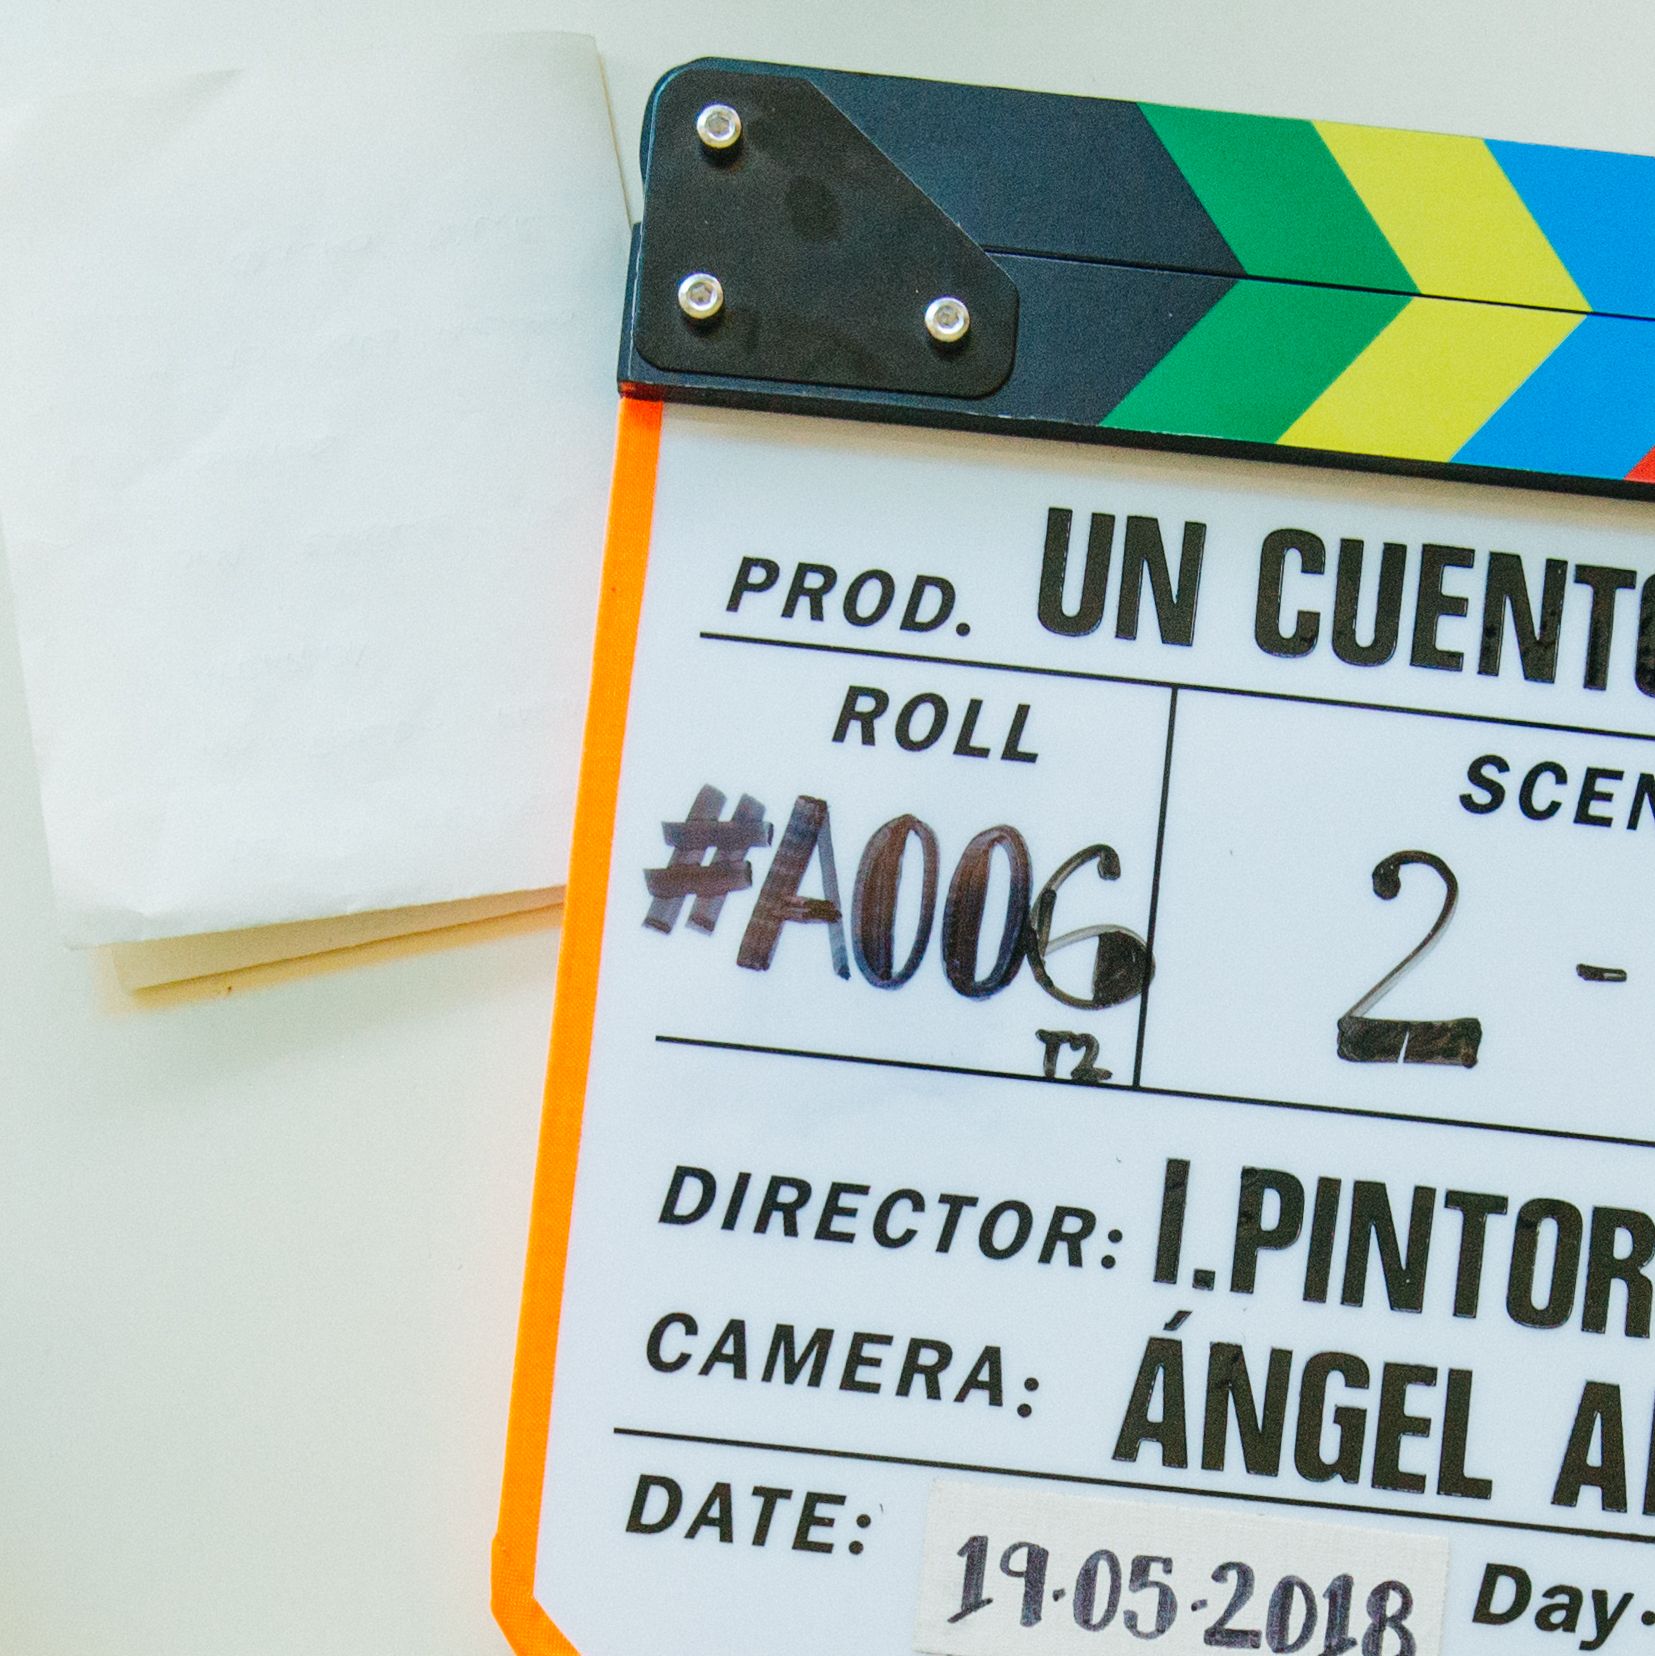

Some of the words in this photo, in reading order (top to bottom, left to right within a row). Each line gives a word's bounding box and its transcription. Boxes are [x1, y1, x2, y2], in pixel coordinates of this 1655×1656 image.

[726, 556, 973, 638] PROD.
[1037, 507, 1207, 646] UN
[831, 685, 1040, 764] ROLL
[1338, 850, 1482, 1070] 2
[658, 1165, 1124, 1271] DIRECTOR:
[645, 1311, 1040, 1418] CAMERA:
[1111, 1311, 1493, 1502] ÁNGEL
[625, 1474, 872, 1555] DATE:
